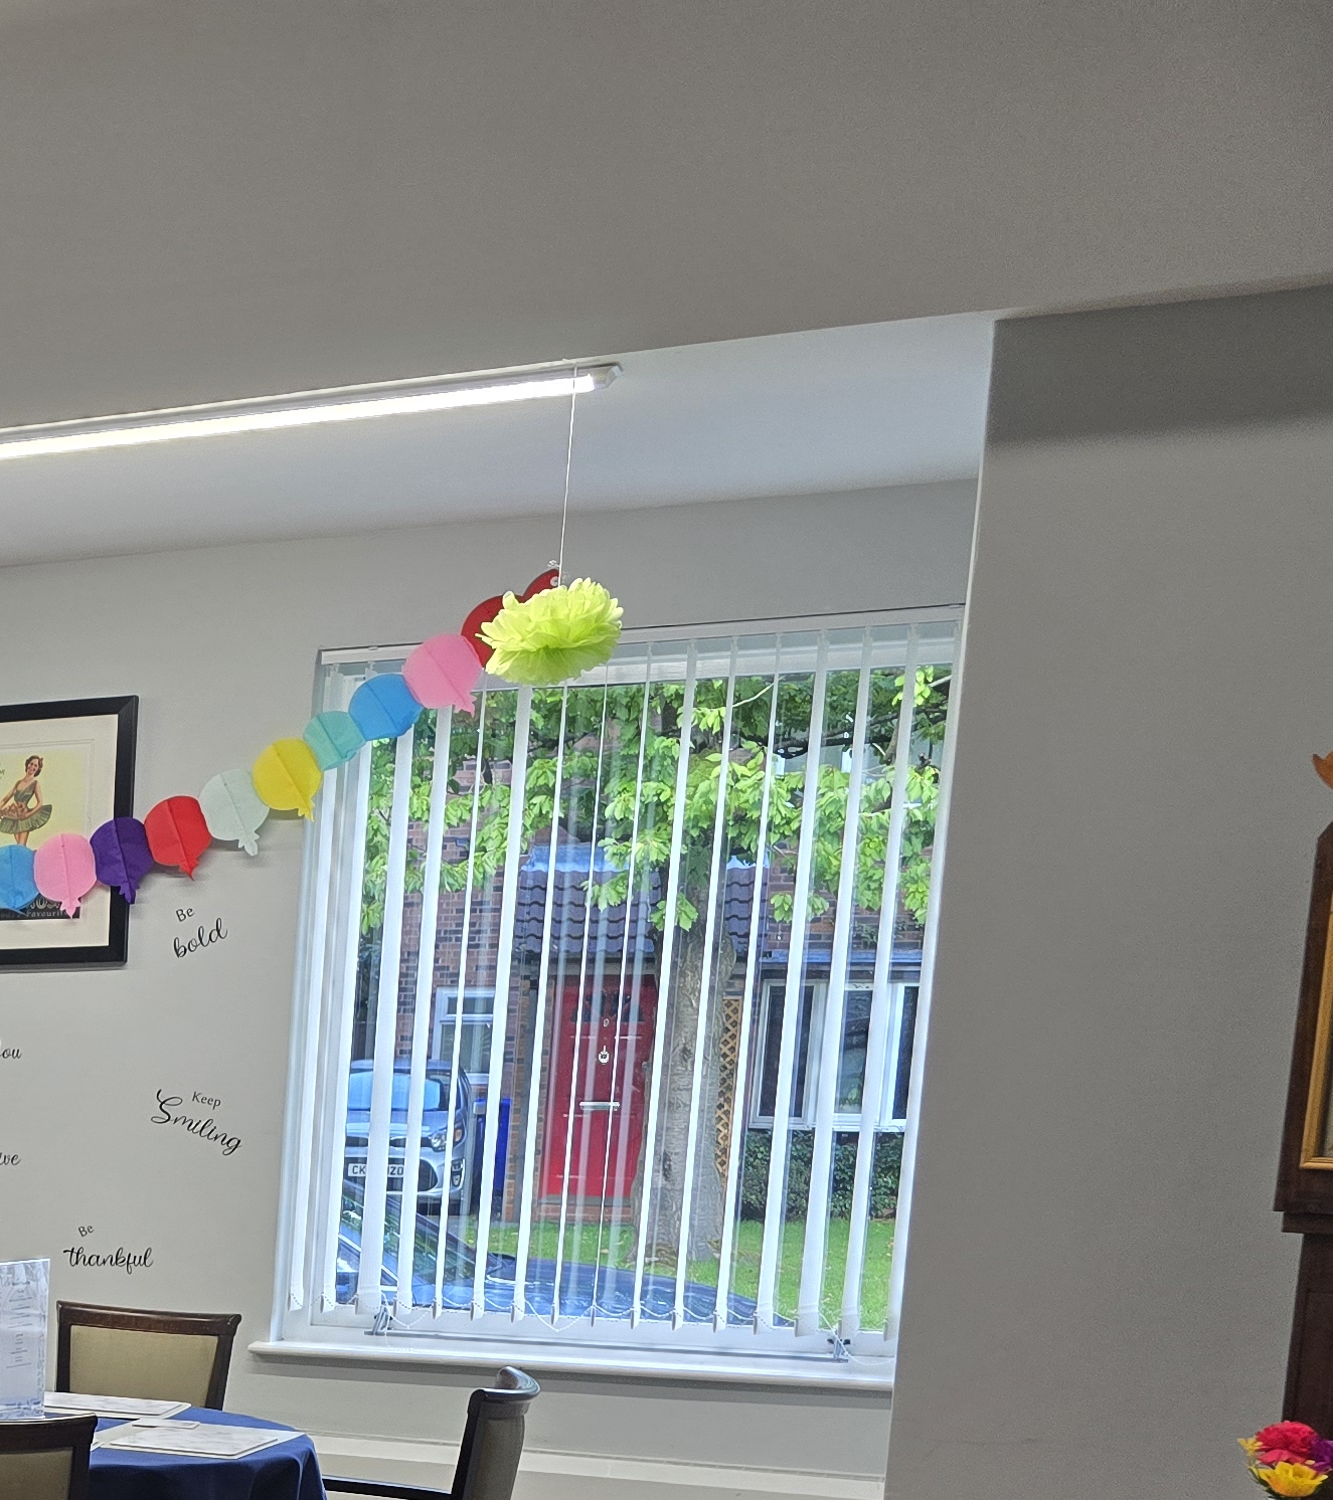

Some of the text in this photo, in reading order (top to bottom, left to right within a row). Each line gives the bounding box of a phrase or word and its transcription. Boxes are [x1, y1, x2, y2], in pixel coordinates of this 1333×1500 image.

[176, 905, 195, 924] Be
[173, 917, 228, 959] bold
[191, 1090, 222, 1110] Keep
[151, 1089, 242, 1156] Smiling
[77, 1223, 95, 1237] Be
[63, 1246, 154, 1274] thankful
